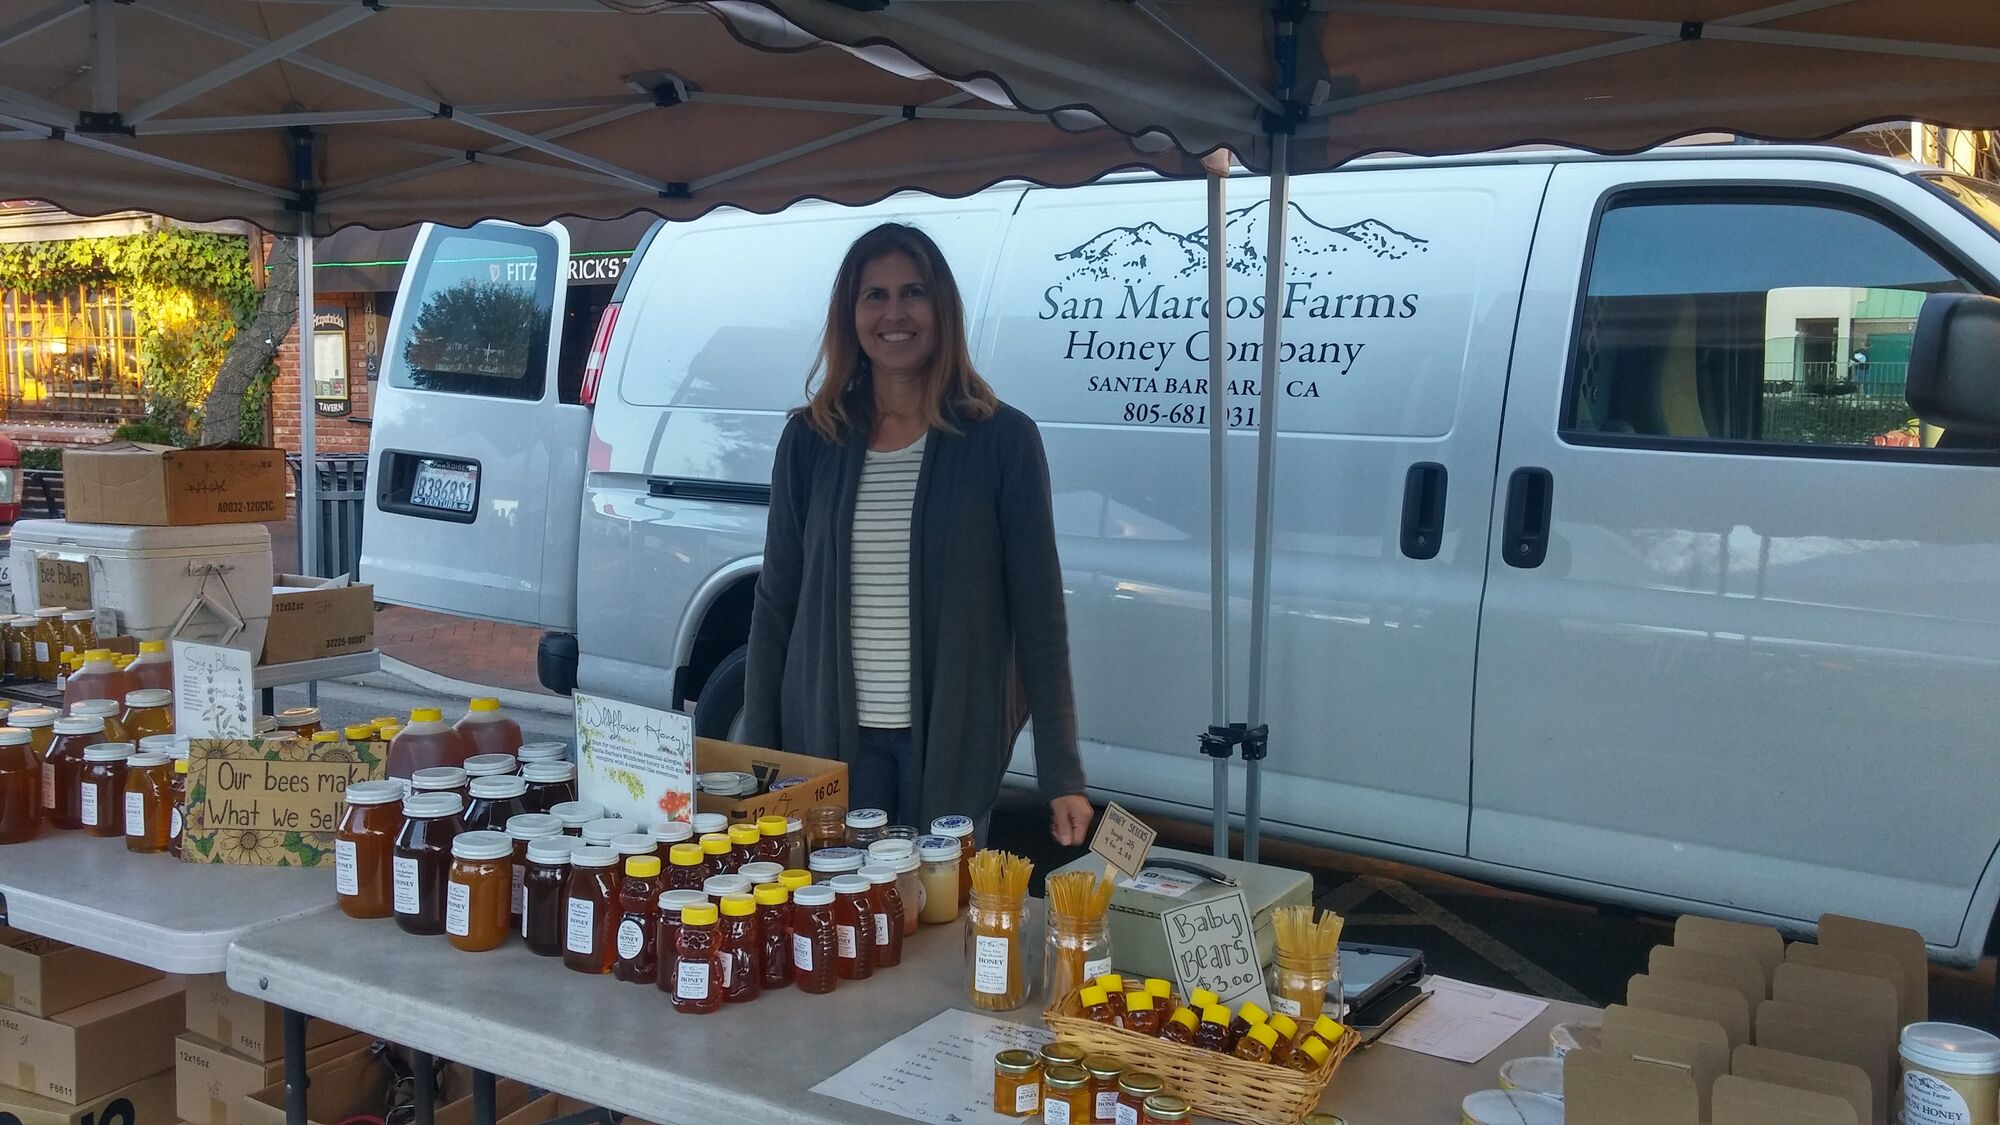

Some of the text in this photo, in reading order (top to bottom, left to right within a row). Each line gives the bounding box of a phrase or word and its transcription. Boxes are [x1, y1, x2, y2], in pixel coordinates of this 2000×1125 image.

[1038, 284, 1103, 320] San
[1282, 282, 1420, 319] Farms
[1063, 330, 1176, 371] Honey
[1087, 376, 1320, 398] SANTA BARAR CA
[318, 402, 344, 413] TAVERN
[1123, 402, 1262, 427] 805-68131
[424, 498, 458, 509] VENTURA
[40, 562, 83, 587] Bee Pollen
[586, 701, 682, 751] Wildflower Honey
[218, 761, 252, 791] Our
[264, 762, 310, 793] bees
[814, 789, 825, 802] 16
[208, 799, 260, 826] What
[1108, 810, 1127, 827] HONEY
[1173, 905, 1243, 944] Baby
[978, 957, 1004, 965] HONEY
[1181, 940, 1249, 983] Bears
[50, 1083, 72, 1097] F6611
[1018, 1092, 1038, 1100] HONEY
[1922, 1105, 1963, 1120] HONEY
